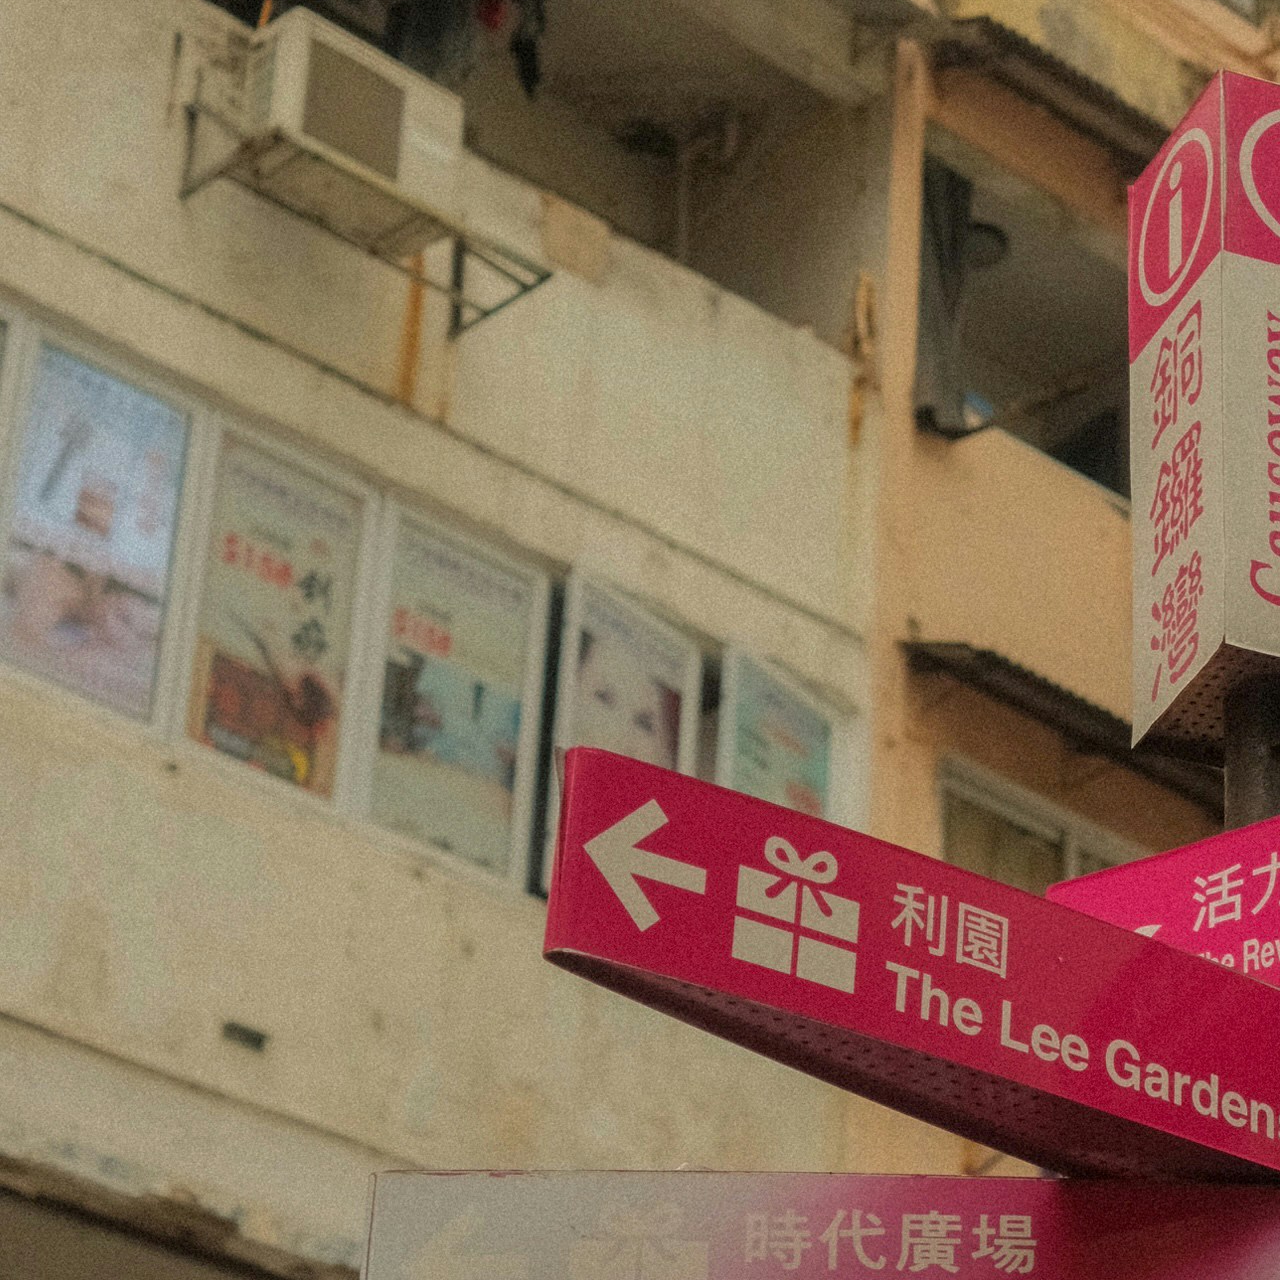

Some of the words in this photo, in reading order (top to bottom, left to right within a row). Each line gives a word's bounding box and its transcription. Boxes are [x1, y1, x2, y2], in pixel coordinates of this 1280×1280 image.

[1151, 299, 1204, 702] 銅鑼灣
[891, 882, 1009, 979] 利園
[886, 960, 983, 1036] The
[1000, 1001, 1089, 1072] Lee
[743, 1209, 1038, 1275] 時代廣場
